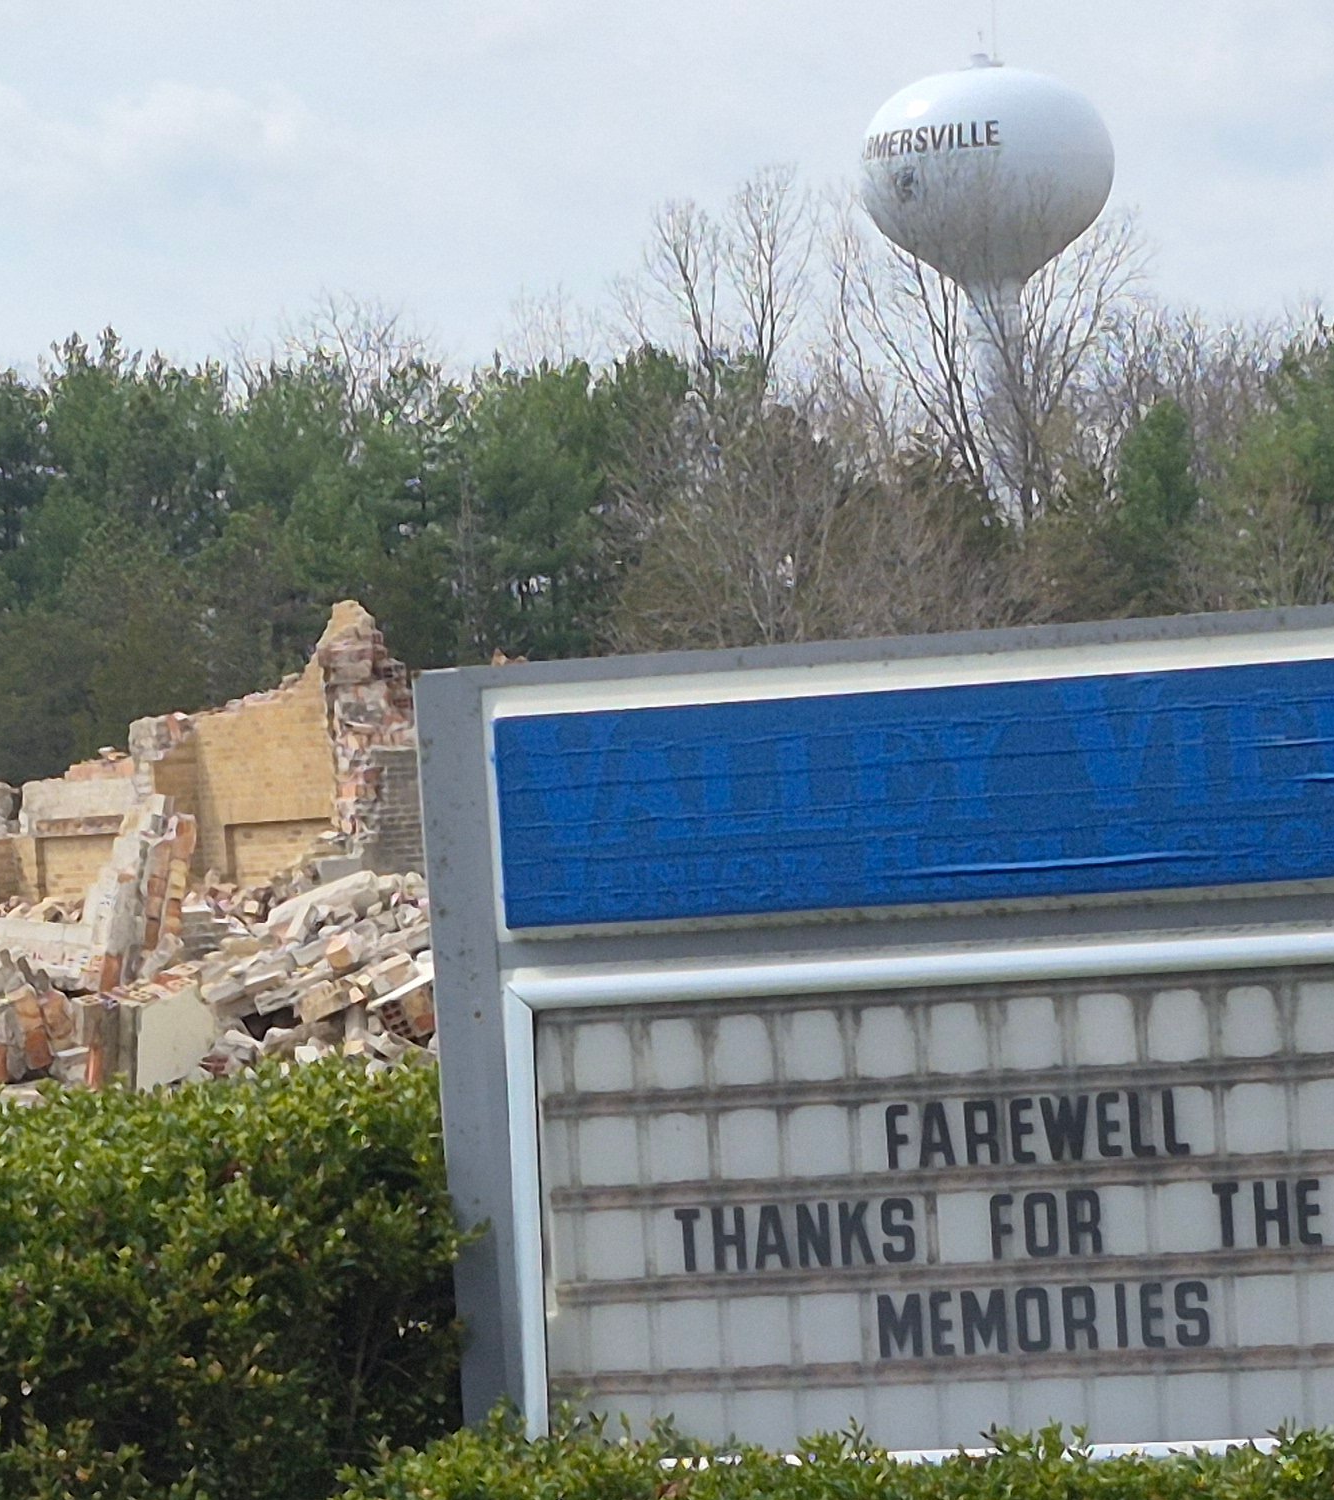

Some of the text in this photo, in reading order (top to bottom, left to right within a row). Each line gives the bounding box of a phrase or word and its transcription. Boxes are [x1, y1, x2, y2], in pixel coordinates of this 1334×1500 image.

[884, 1089, 1191, 1169] FAREWELL
[674, 1179, 1323, 1272] THANKS FOR THE
[877, 1280, 1211, 1358] MEMORIES
